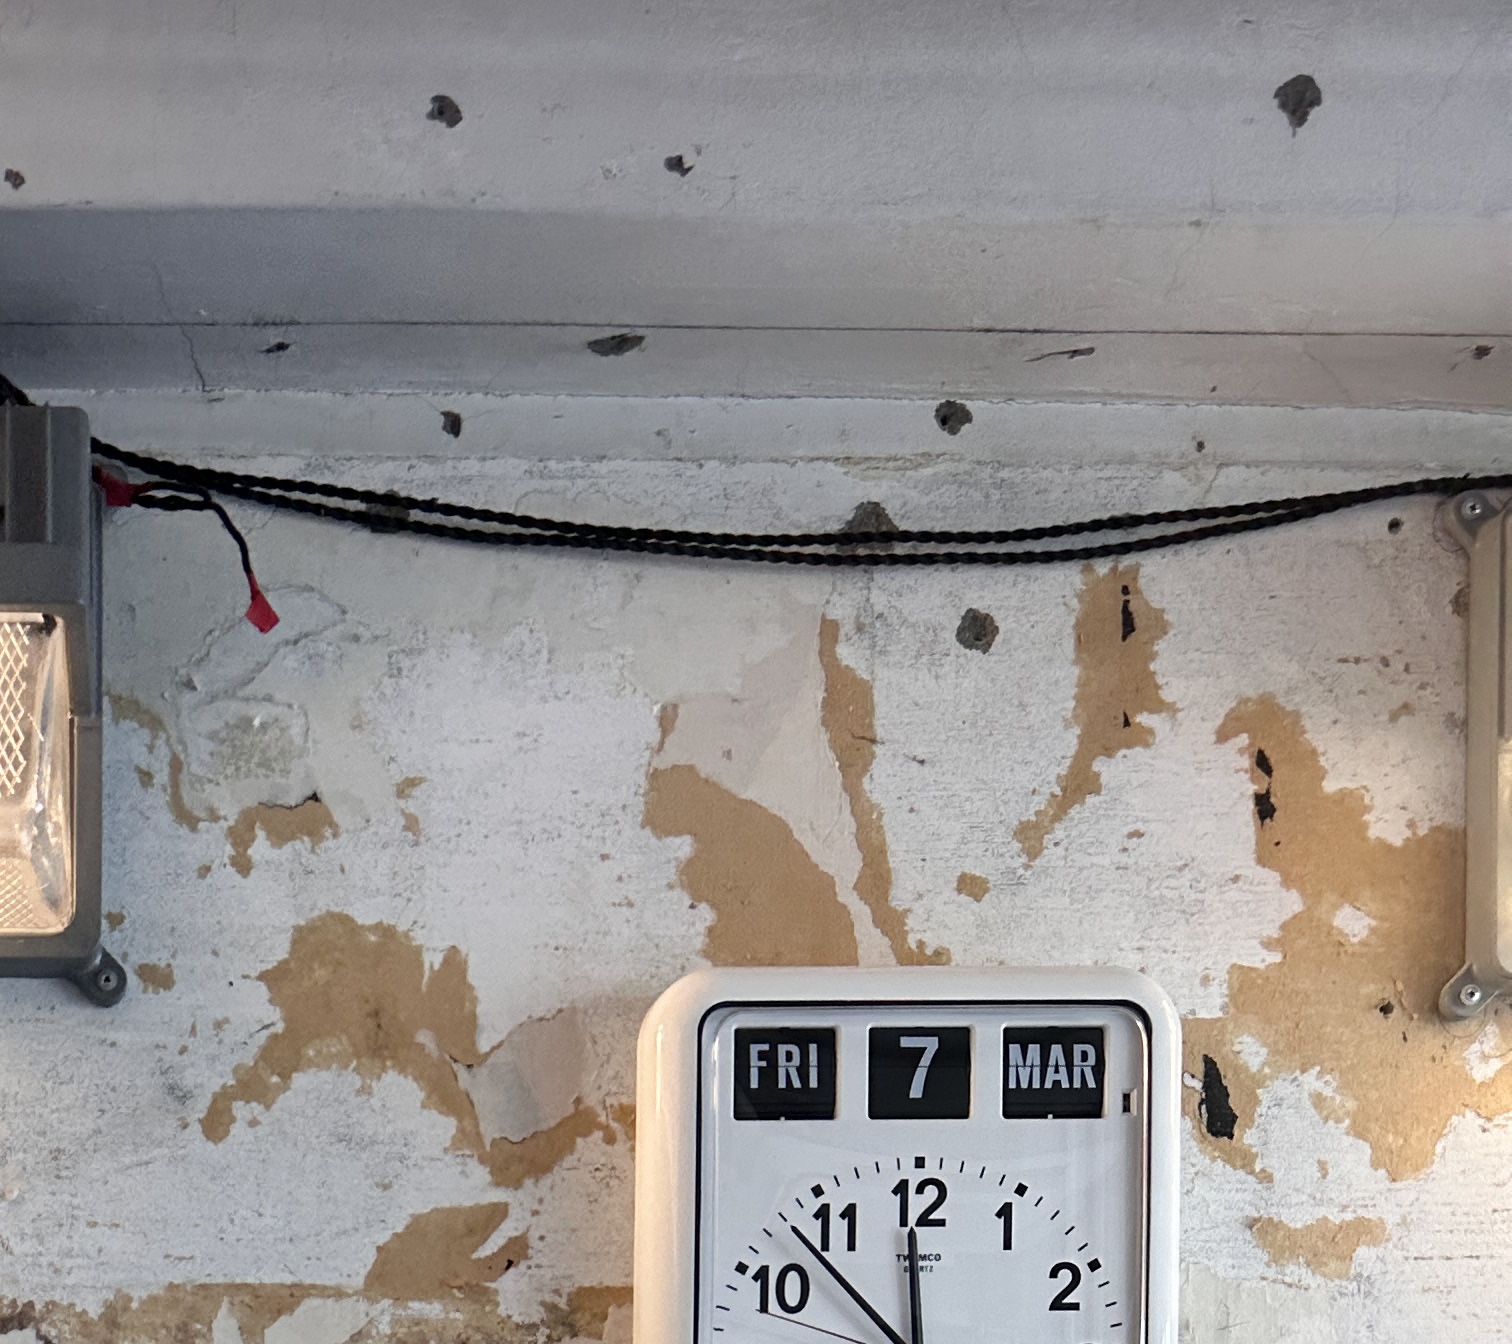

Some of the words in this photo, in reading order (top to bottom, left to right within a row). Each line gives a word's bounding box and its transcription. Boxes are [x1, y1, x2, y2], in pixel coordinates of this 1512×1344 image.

[748, 1042, 819, 1089] FRI
[899, 1035, 940, 1099] 7
[1008, 1043, 1097, 1089] MAR
[813, 1202, 858, 1252] 11
[891, 1177, 947, 1228] 12
[995, 1201, 1013, 1251] 1
[752, 1263, 811, 1314] 10
[1048, 1262, 1082, 1312] 2
